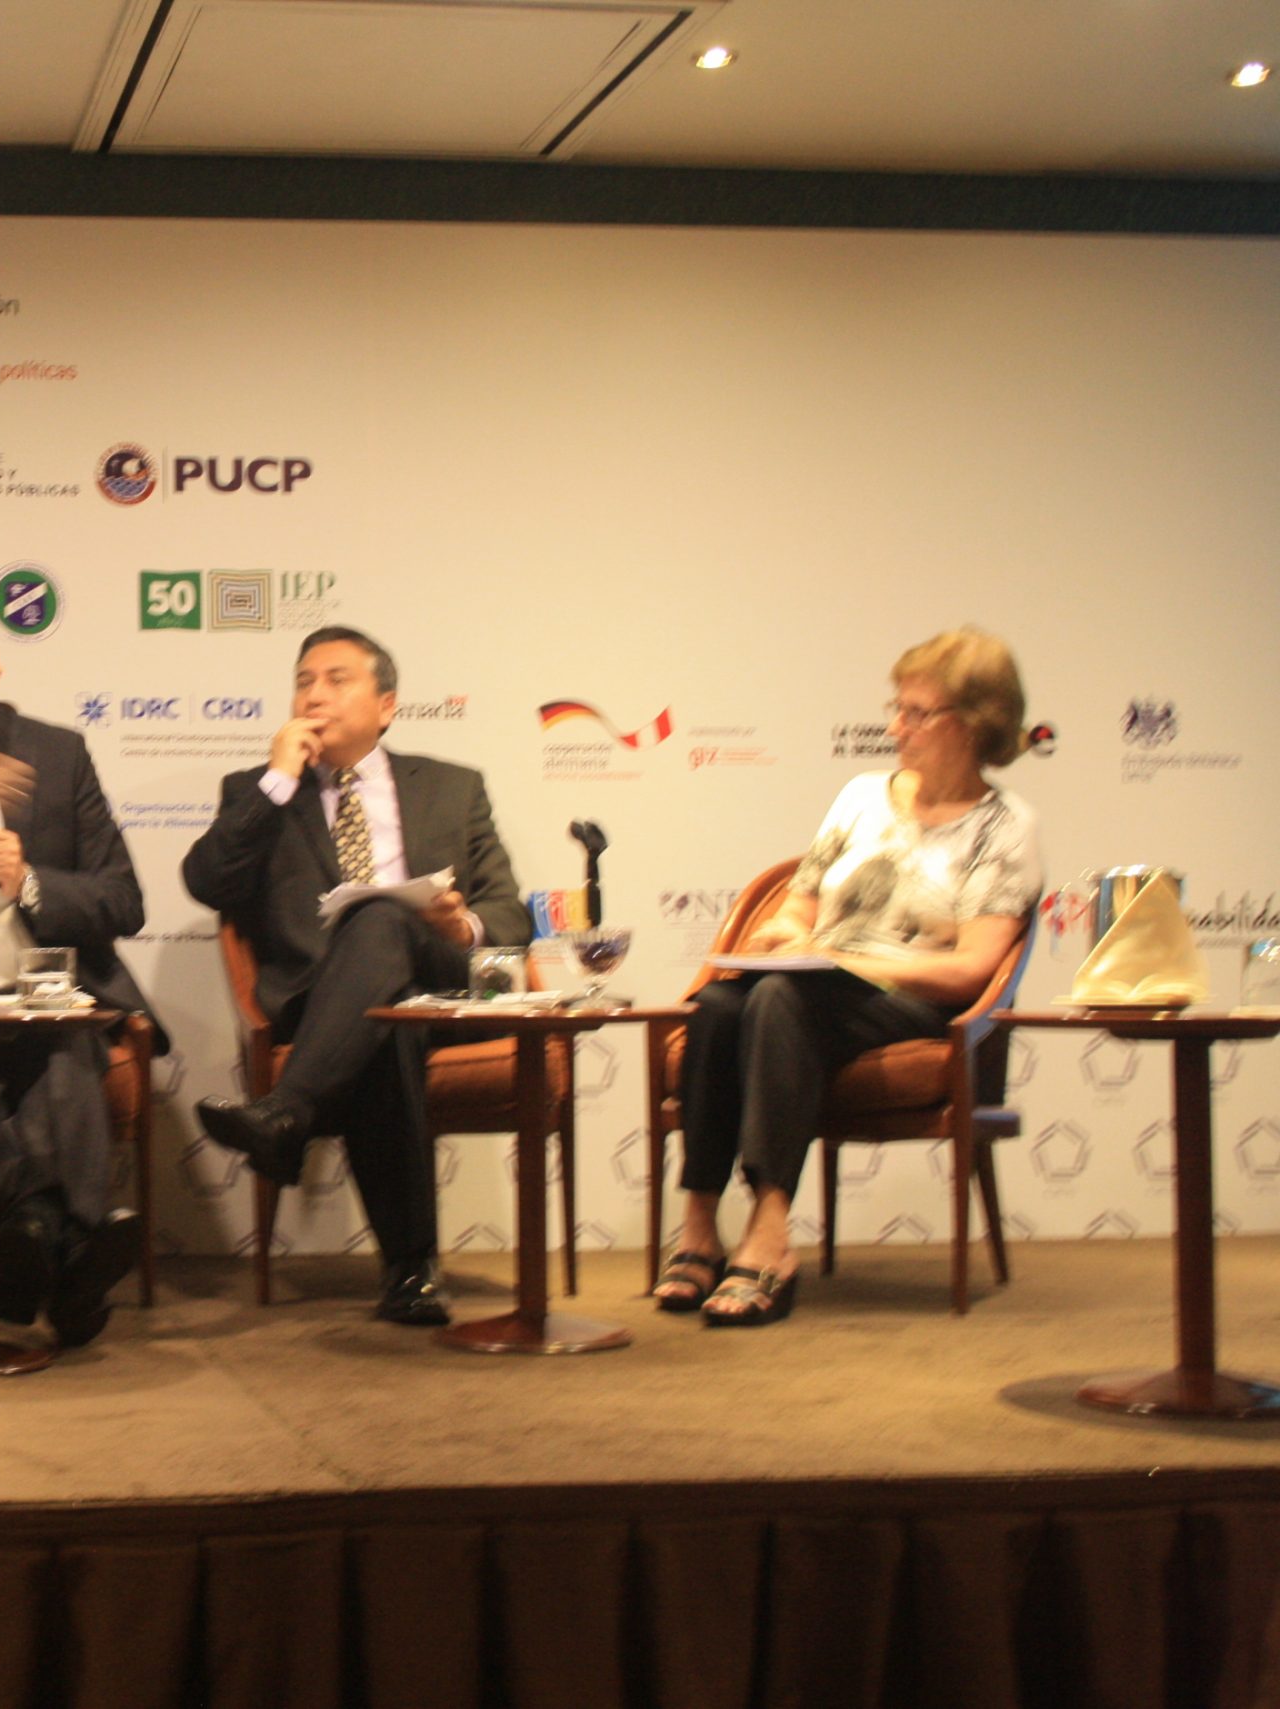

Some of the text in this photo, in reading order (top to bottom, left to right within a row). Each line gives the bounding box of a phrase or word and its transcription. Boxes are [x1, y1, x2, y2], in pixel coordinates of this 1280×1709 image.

[0, 359, 78, 384] políticas
[172, 456, 314, 494] PUCP
[146, 579, 198, 617] 50
[278, 570, 337, 600] IEP
[121, 697, 181, 719] IDRC
[202, 697, 264, 719] CRDI
